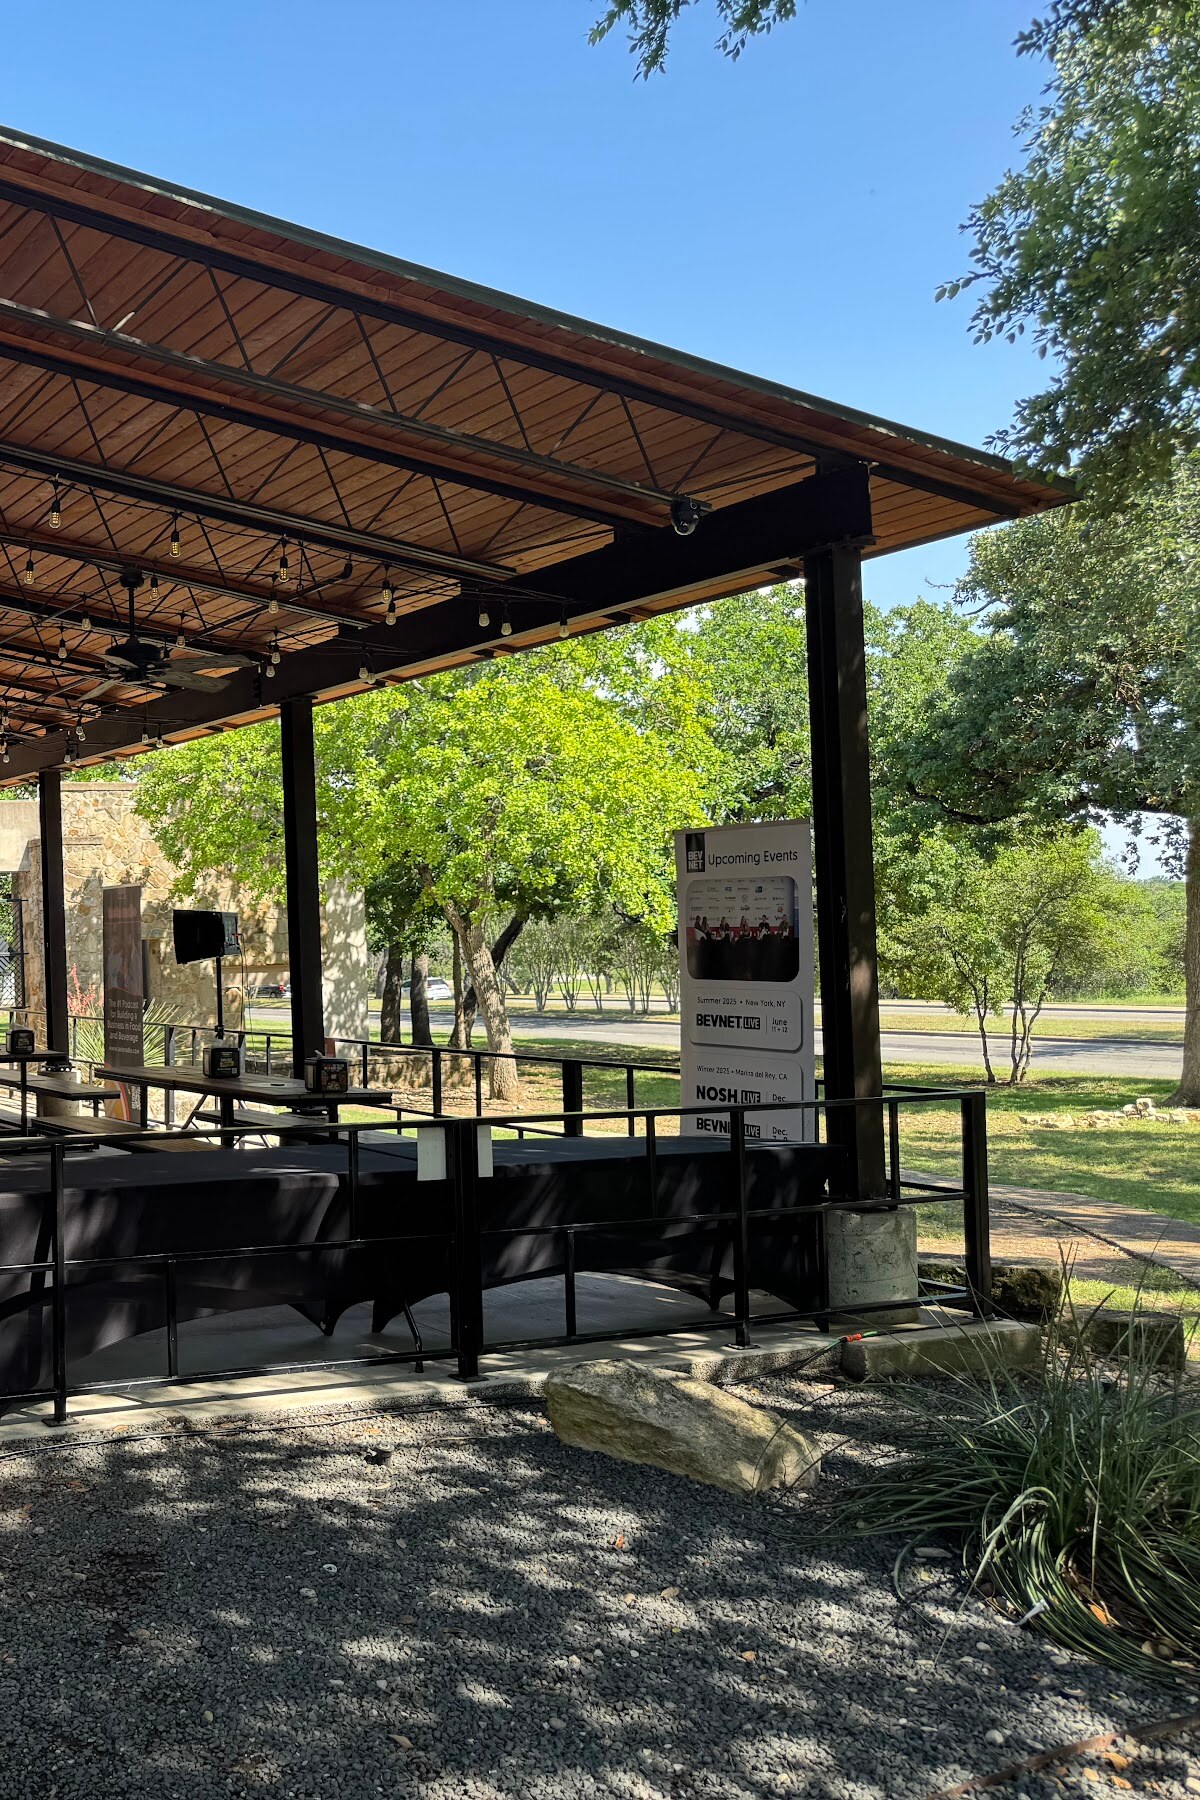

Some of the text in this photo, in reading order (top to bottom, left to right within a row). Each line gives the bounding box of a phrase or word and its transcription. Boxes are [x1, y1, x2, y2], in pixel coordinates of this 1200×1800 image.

[708, 850, 798, 867] Upcoming Events
[760, 1000, 775, 1008] York,
[744, 1017, 760, 1029] LIVE
[772, 1017, 787, 1026] June
[742, 1090, 760, 1104] LIVE
[696, 1118, 760, 1138] BEVN LIVE
